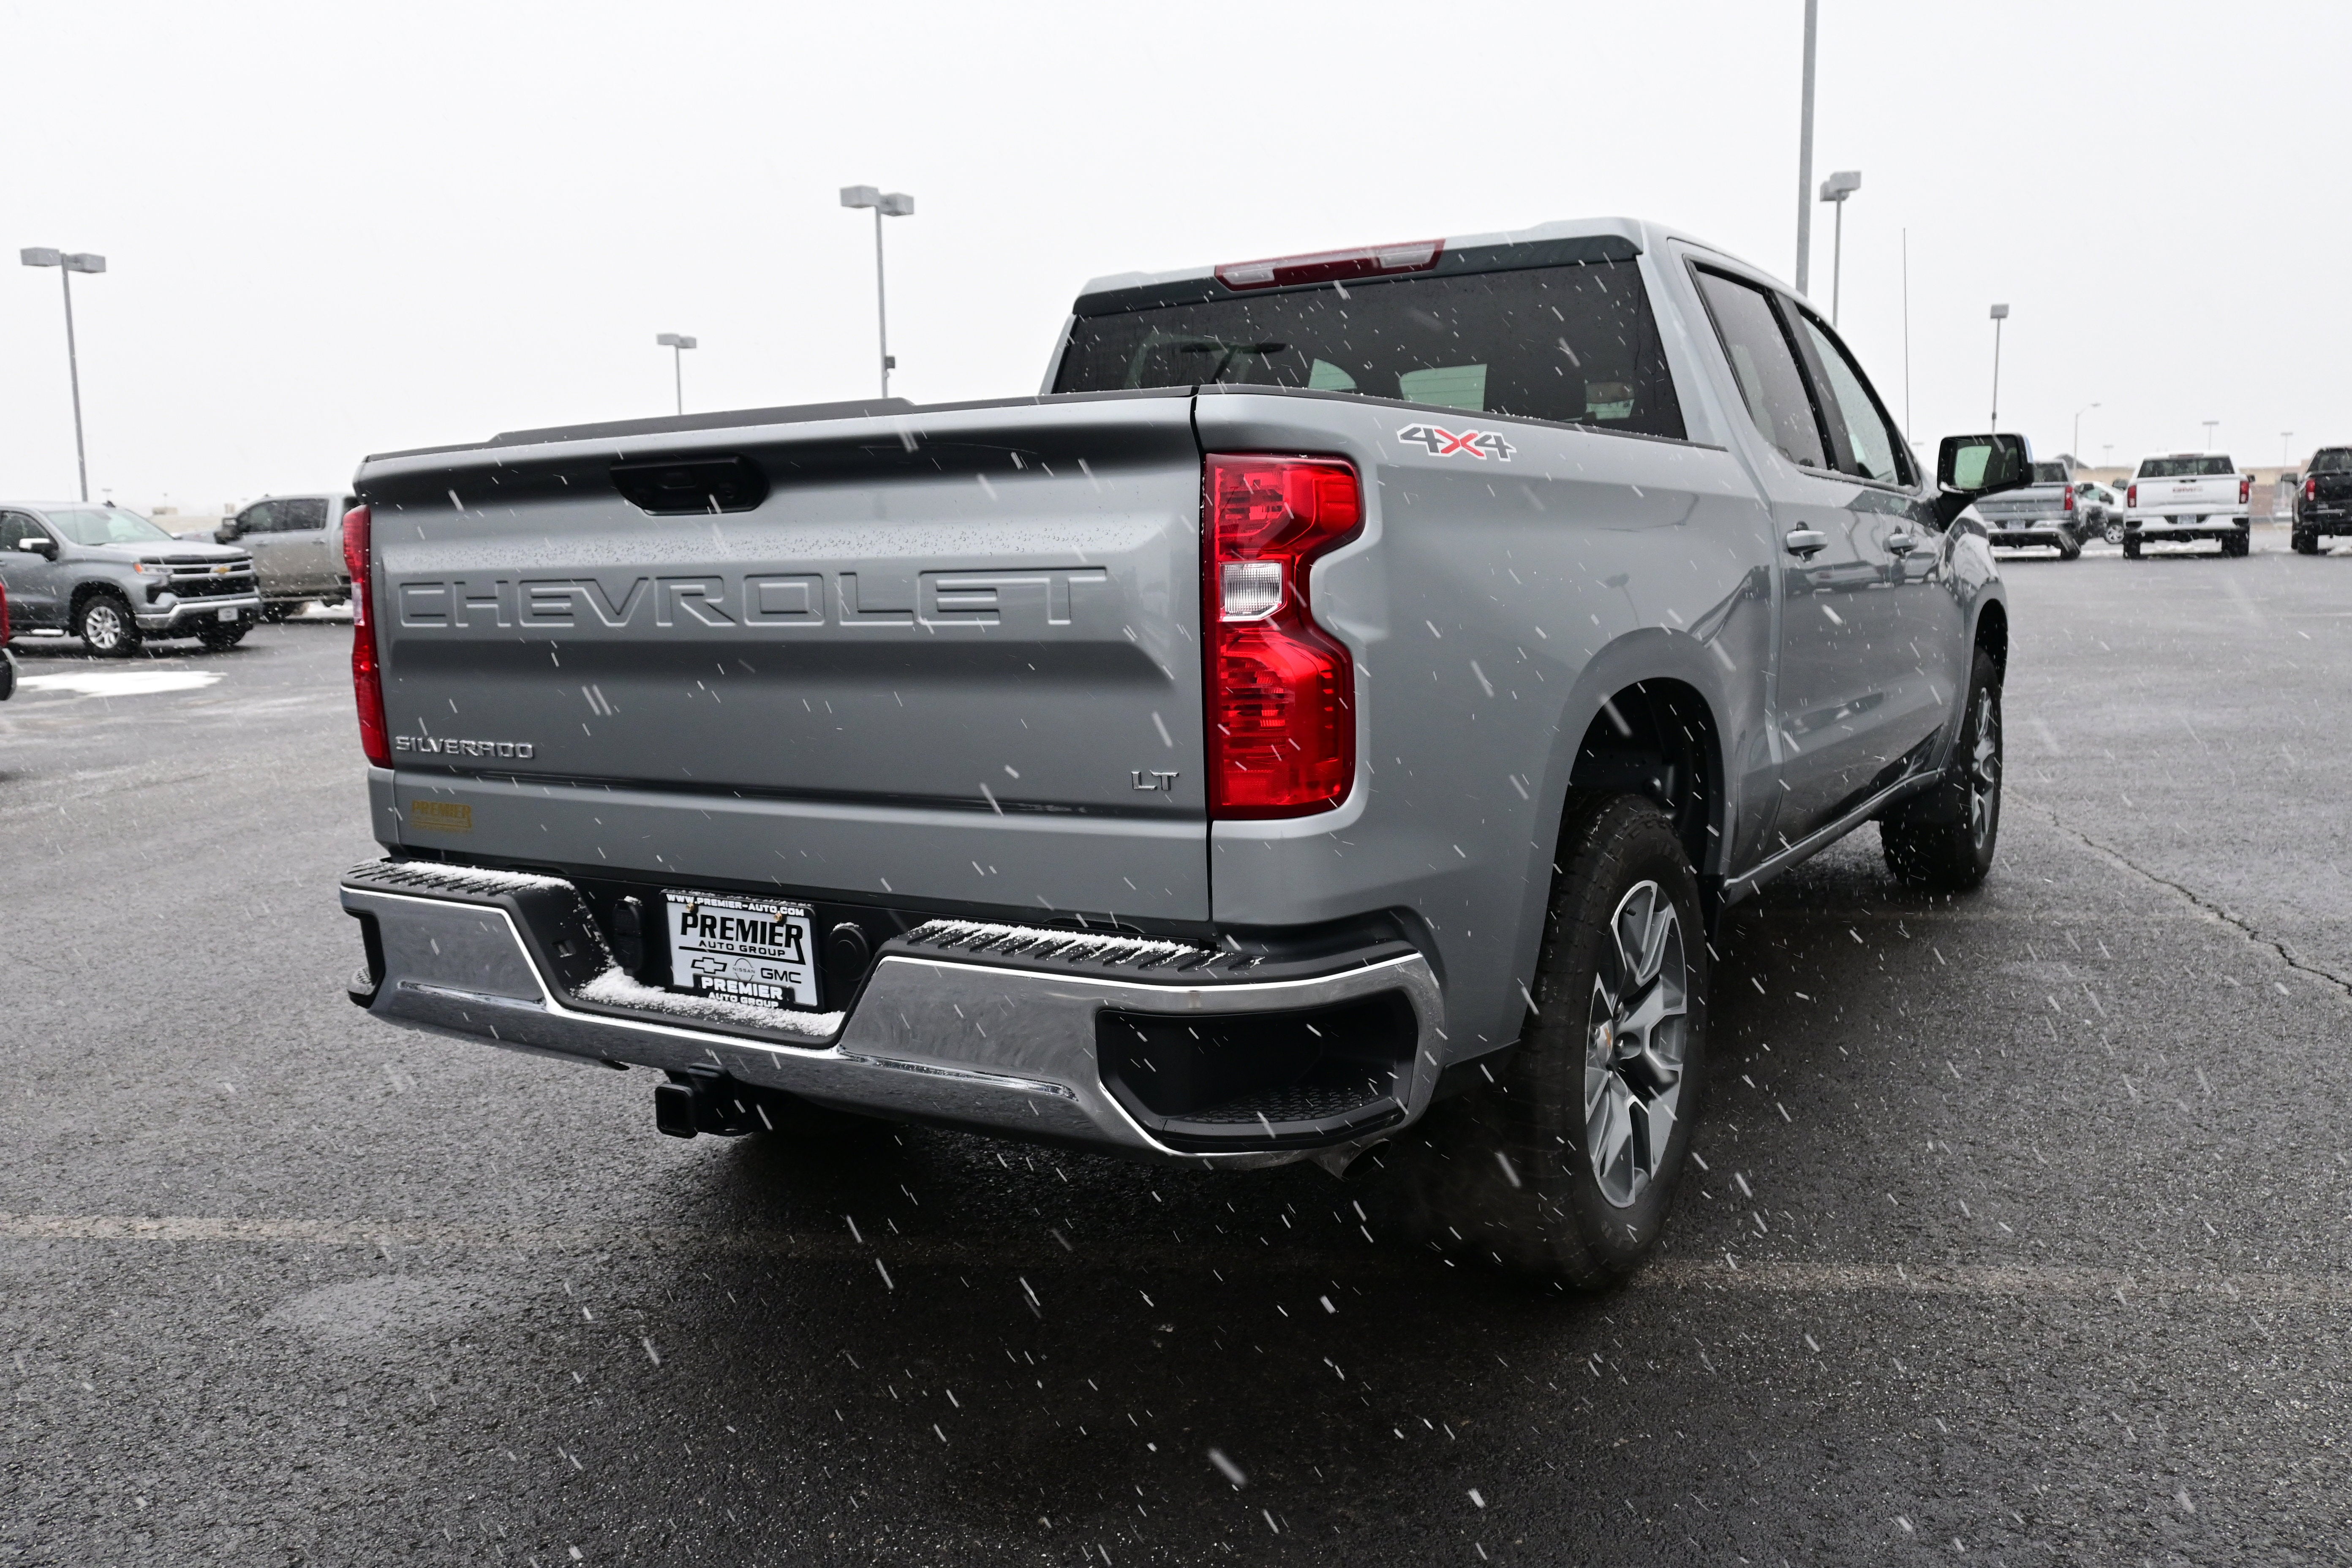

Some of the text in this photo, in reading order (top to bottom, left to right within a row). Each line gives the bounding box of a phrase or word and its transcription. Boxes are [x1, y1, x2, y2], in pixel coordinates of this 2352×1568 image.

[399, 566, 1107, 627] CHEVROLET
[395, 735, 534, 759] SILVERADO
[1131, 770, 1179, 790] LT
[666, 893, 805, 917] WWW.PREMIER-AUTO.COM
[680, 912, 803, 948] PREMIER
[699, 940, 785, 957] AUTO GROUP
[760, 967, 802, 984] GMC
[701, 976, 783, 1000] PREMIER
[708, 991, 779, 1009] AUTO GROUP
